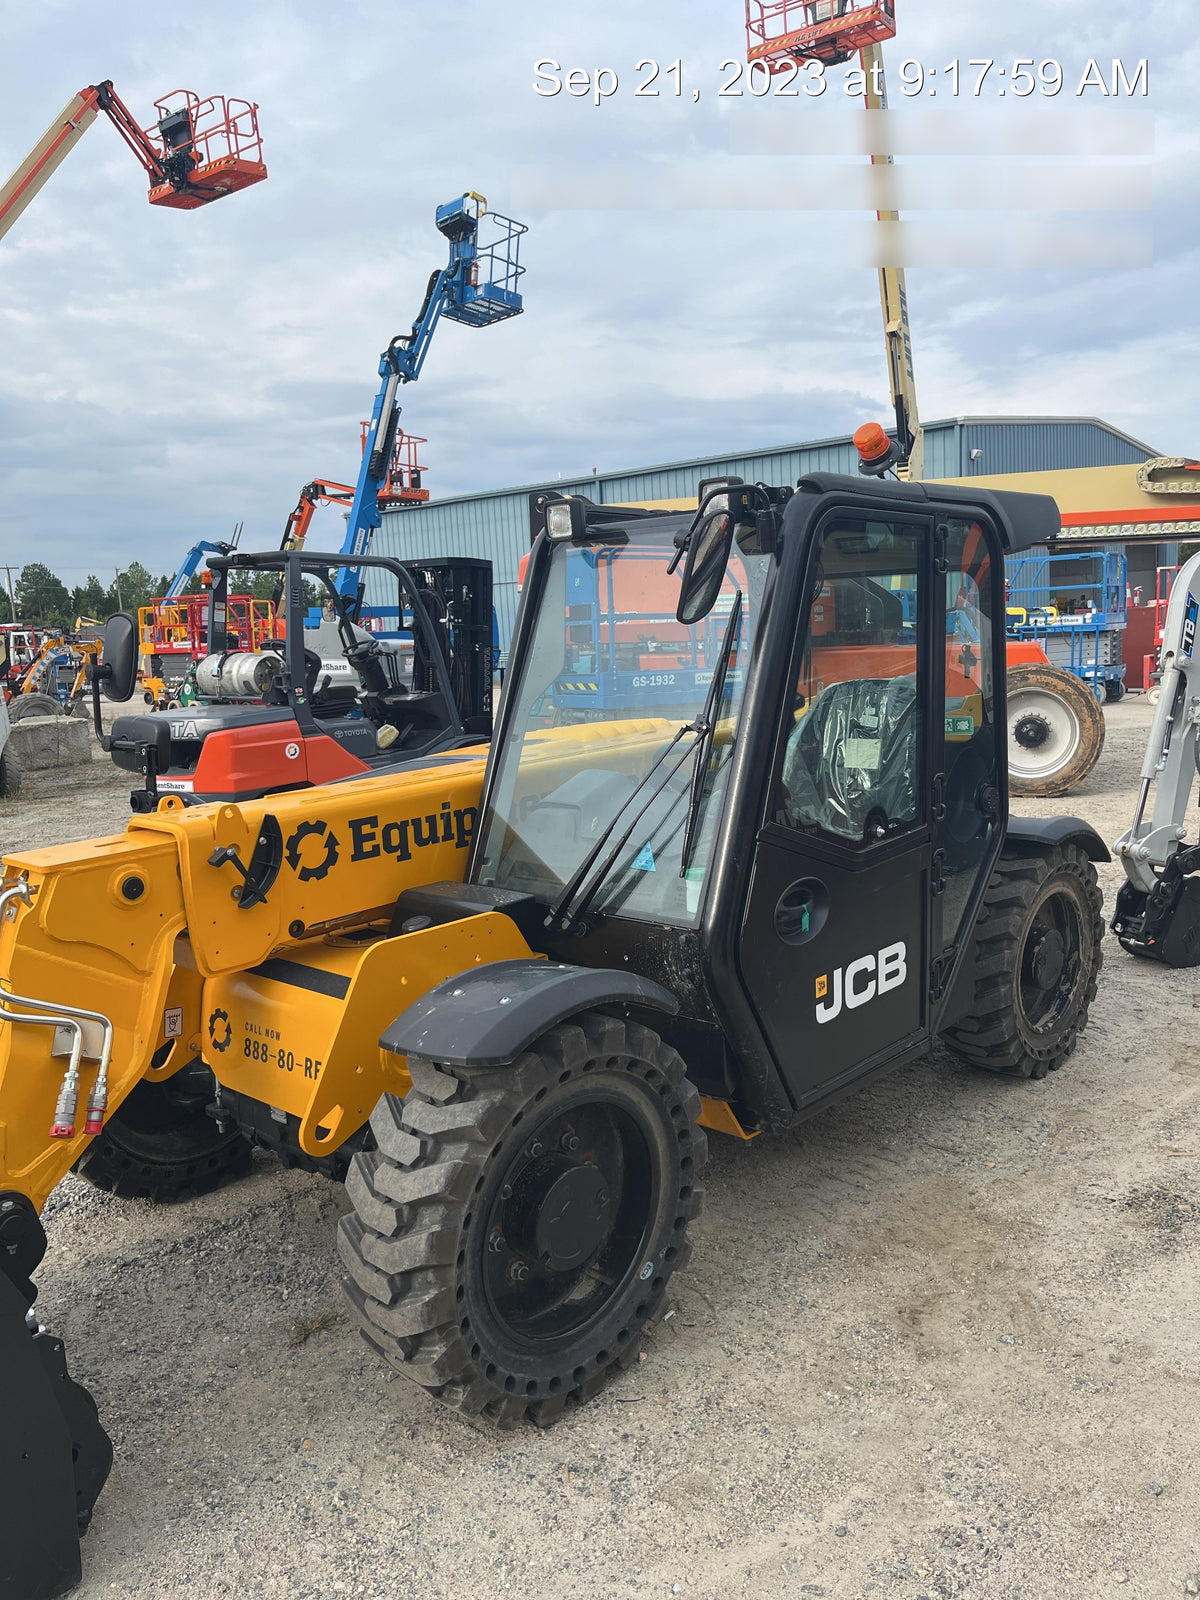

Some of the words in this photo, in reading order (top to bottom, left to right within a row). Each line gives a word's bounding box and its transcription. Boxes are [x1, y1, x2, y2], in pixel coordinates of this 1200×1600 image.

[794, 33, 806, 43] JLG
[807, 28, 823, 39] LIFT
[898, 284, 909, 327] JLG
[903, 332, 914, 382] LIFT
[632, 674, 675, 688] GS-1932
[343, 728, 368, 737] TOYOTA
[348, 801, 479, 863] Equip
[815, 941, 907, 1024] JCB
[244, 1021, 262, 1035] CALL
[264, 1027, 281, 1041] NOW
